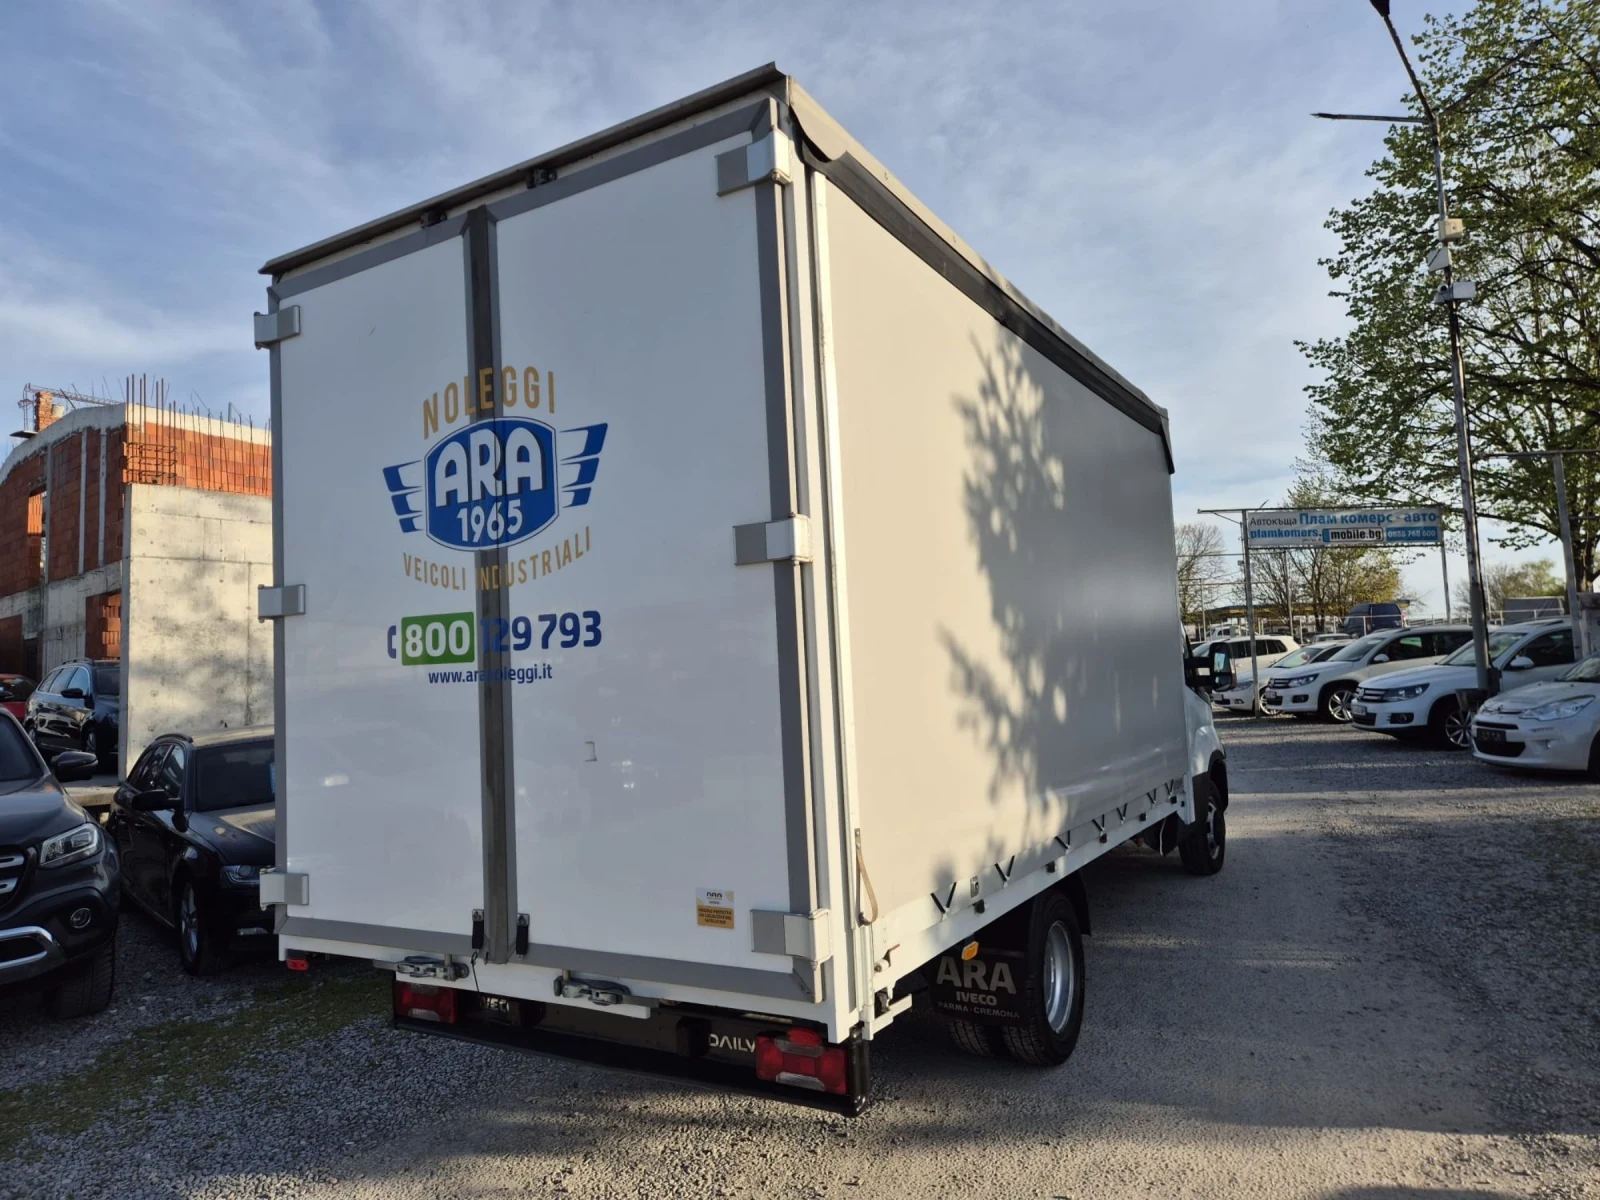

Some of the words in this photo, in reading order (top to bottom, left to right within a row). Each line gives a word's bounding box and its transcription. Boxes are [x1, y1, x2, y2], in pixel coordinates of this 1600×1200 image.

[422, 365, 555, 440] NOLEGGI
[434, 427, 547, 508] ARA
[456, 499, 523, 543] 1965
[1250, 517, 1297, 526] Автокъща
[1300, 513, 1337, 525] Плам
[1340, 513, 1393, 526] комерс
[1404, 513, 1437, 523] авто
[1331, 528, 1382, 542] mobile.bg
[403, 552, 467, 591] VEICOLI
[405, 620, 471, 658] 800
[538, 610, 602, 649] 793
[936, 956, 1017, 995] ARA
[938, 1001, 969, 1012] PARMA
[973, 1007, 1021, 1019] CREMONA
[956, 991, 998, 1007] IVECO
[708, 1033, 756, 1053] DAILY
